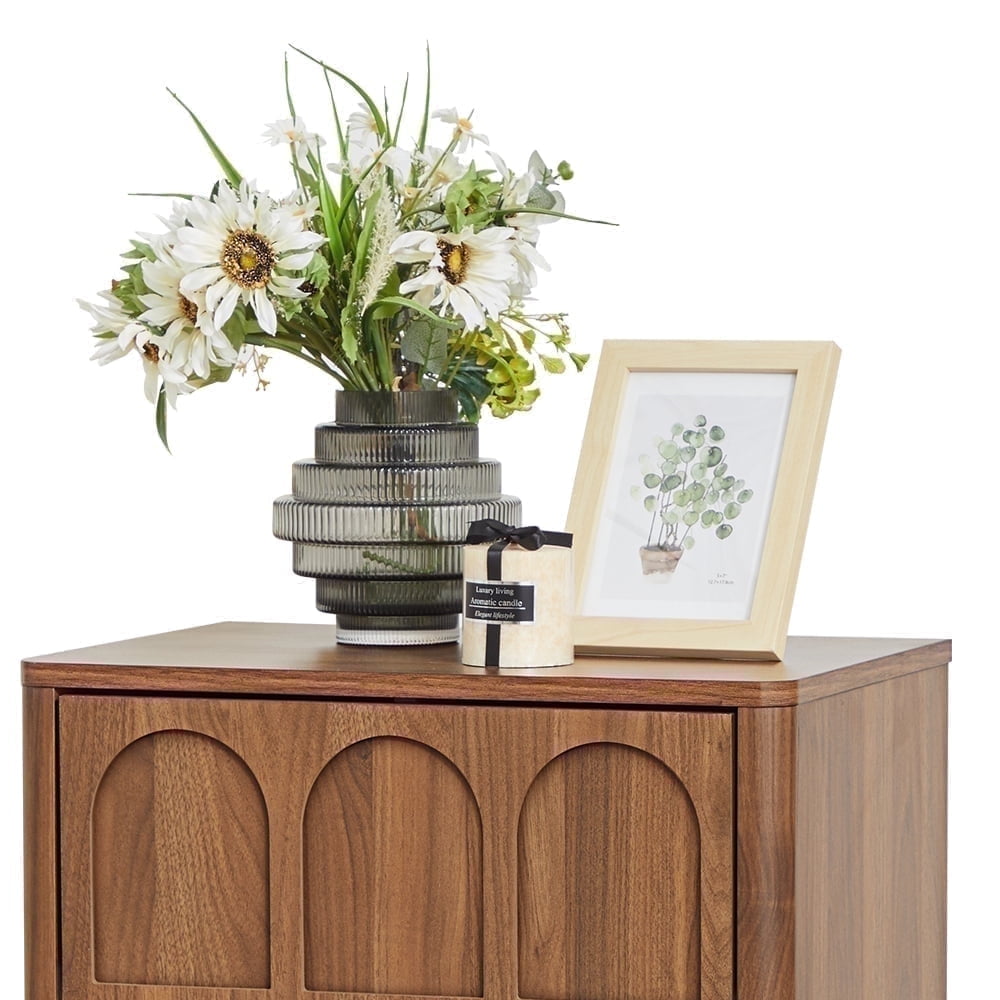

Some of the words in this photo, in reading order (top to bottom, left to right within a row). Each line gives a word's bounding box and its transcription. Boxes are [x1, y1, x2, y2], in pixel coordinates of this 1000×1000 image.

[476, 586, 494, 595] Luxury
[496, 587, 514, 596] living
[470, 597, 496, 606] Aromatic
[498, 598, 522, 607] candle
[475, 610, 492, 619] Elegant
[493, 610, 515, 619] lifestyle
